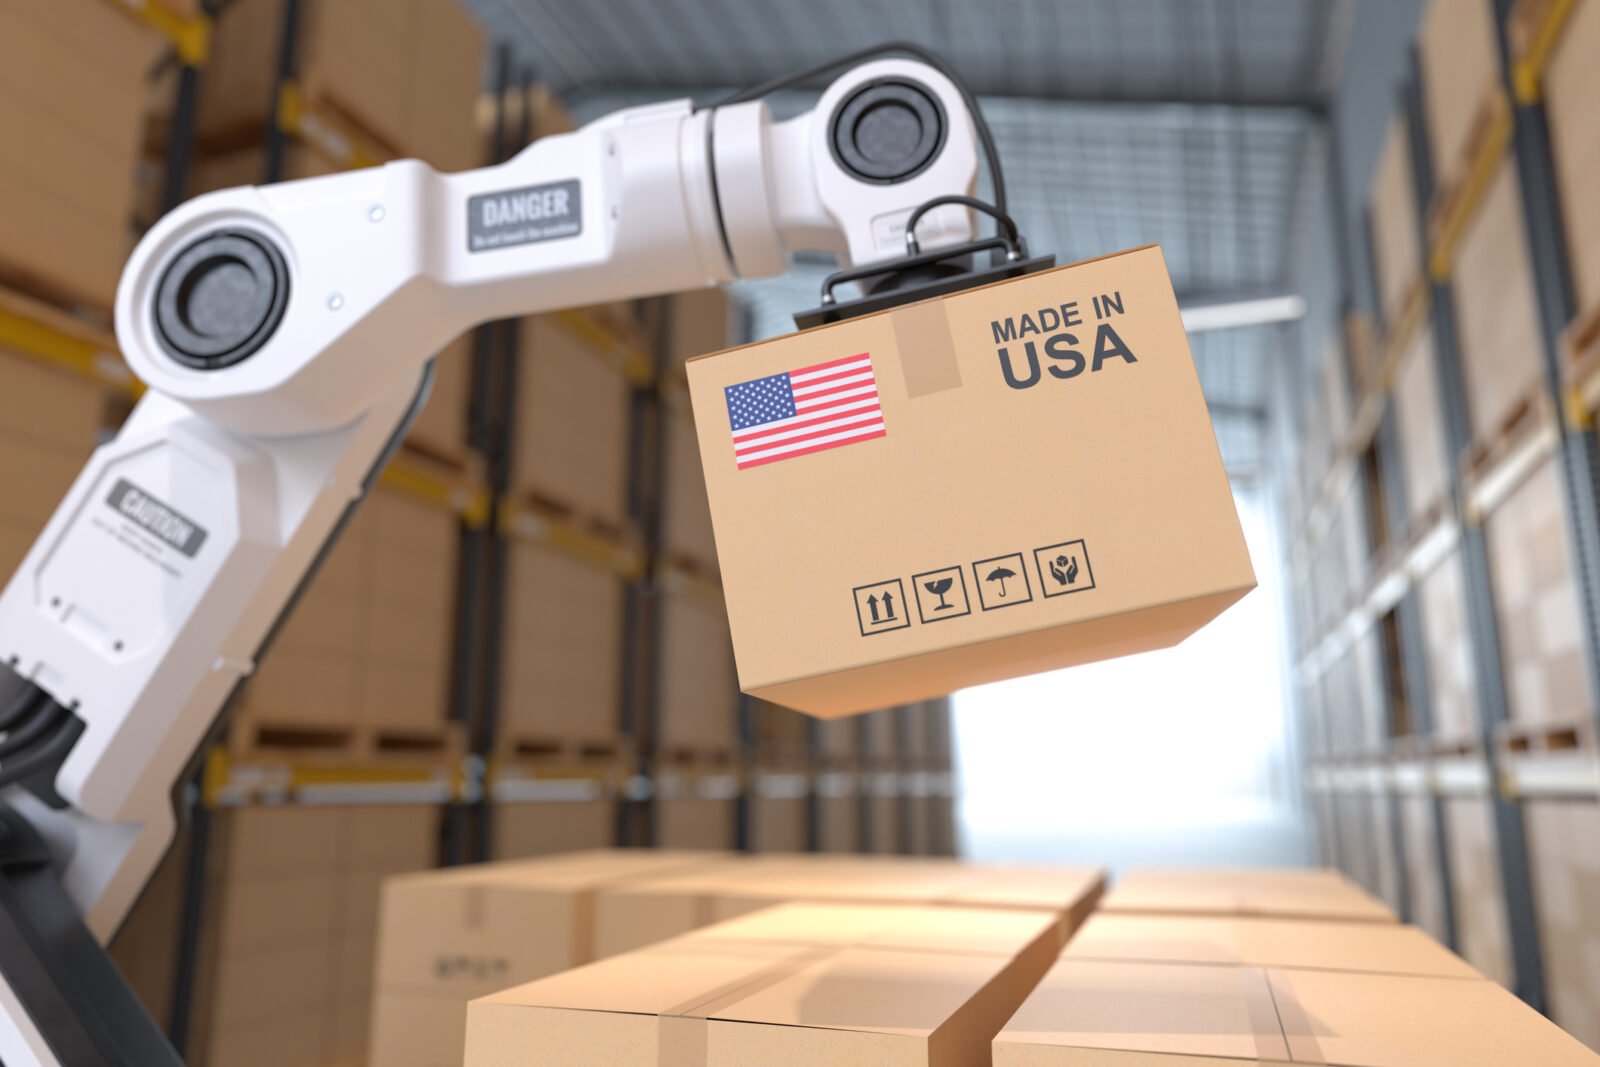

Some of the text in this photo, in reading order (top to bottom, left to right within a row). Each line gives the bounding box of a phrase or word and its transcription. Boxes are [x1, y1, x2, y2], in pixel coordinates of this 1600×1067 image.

[481, 187, 569, 227] DANGER
[991, 291, 1125, 344] MADE IN
[997, 323, 1138, 389] USA
[119, 488, 195, 548] CAUTION
